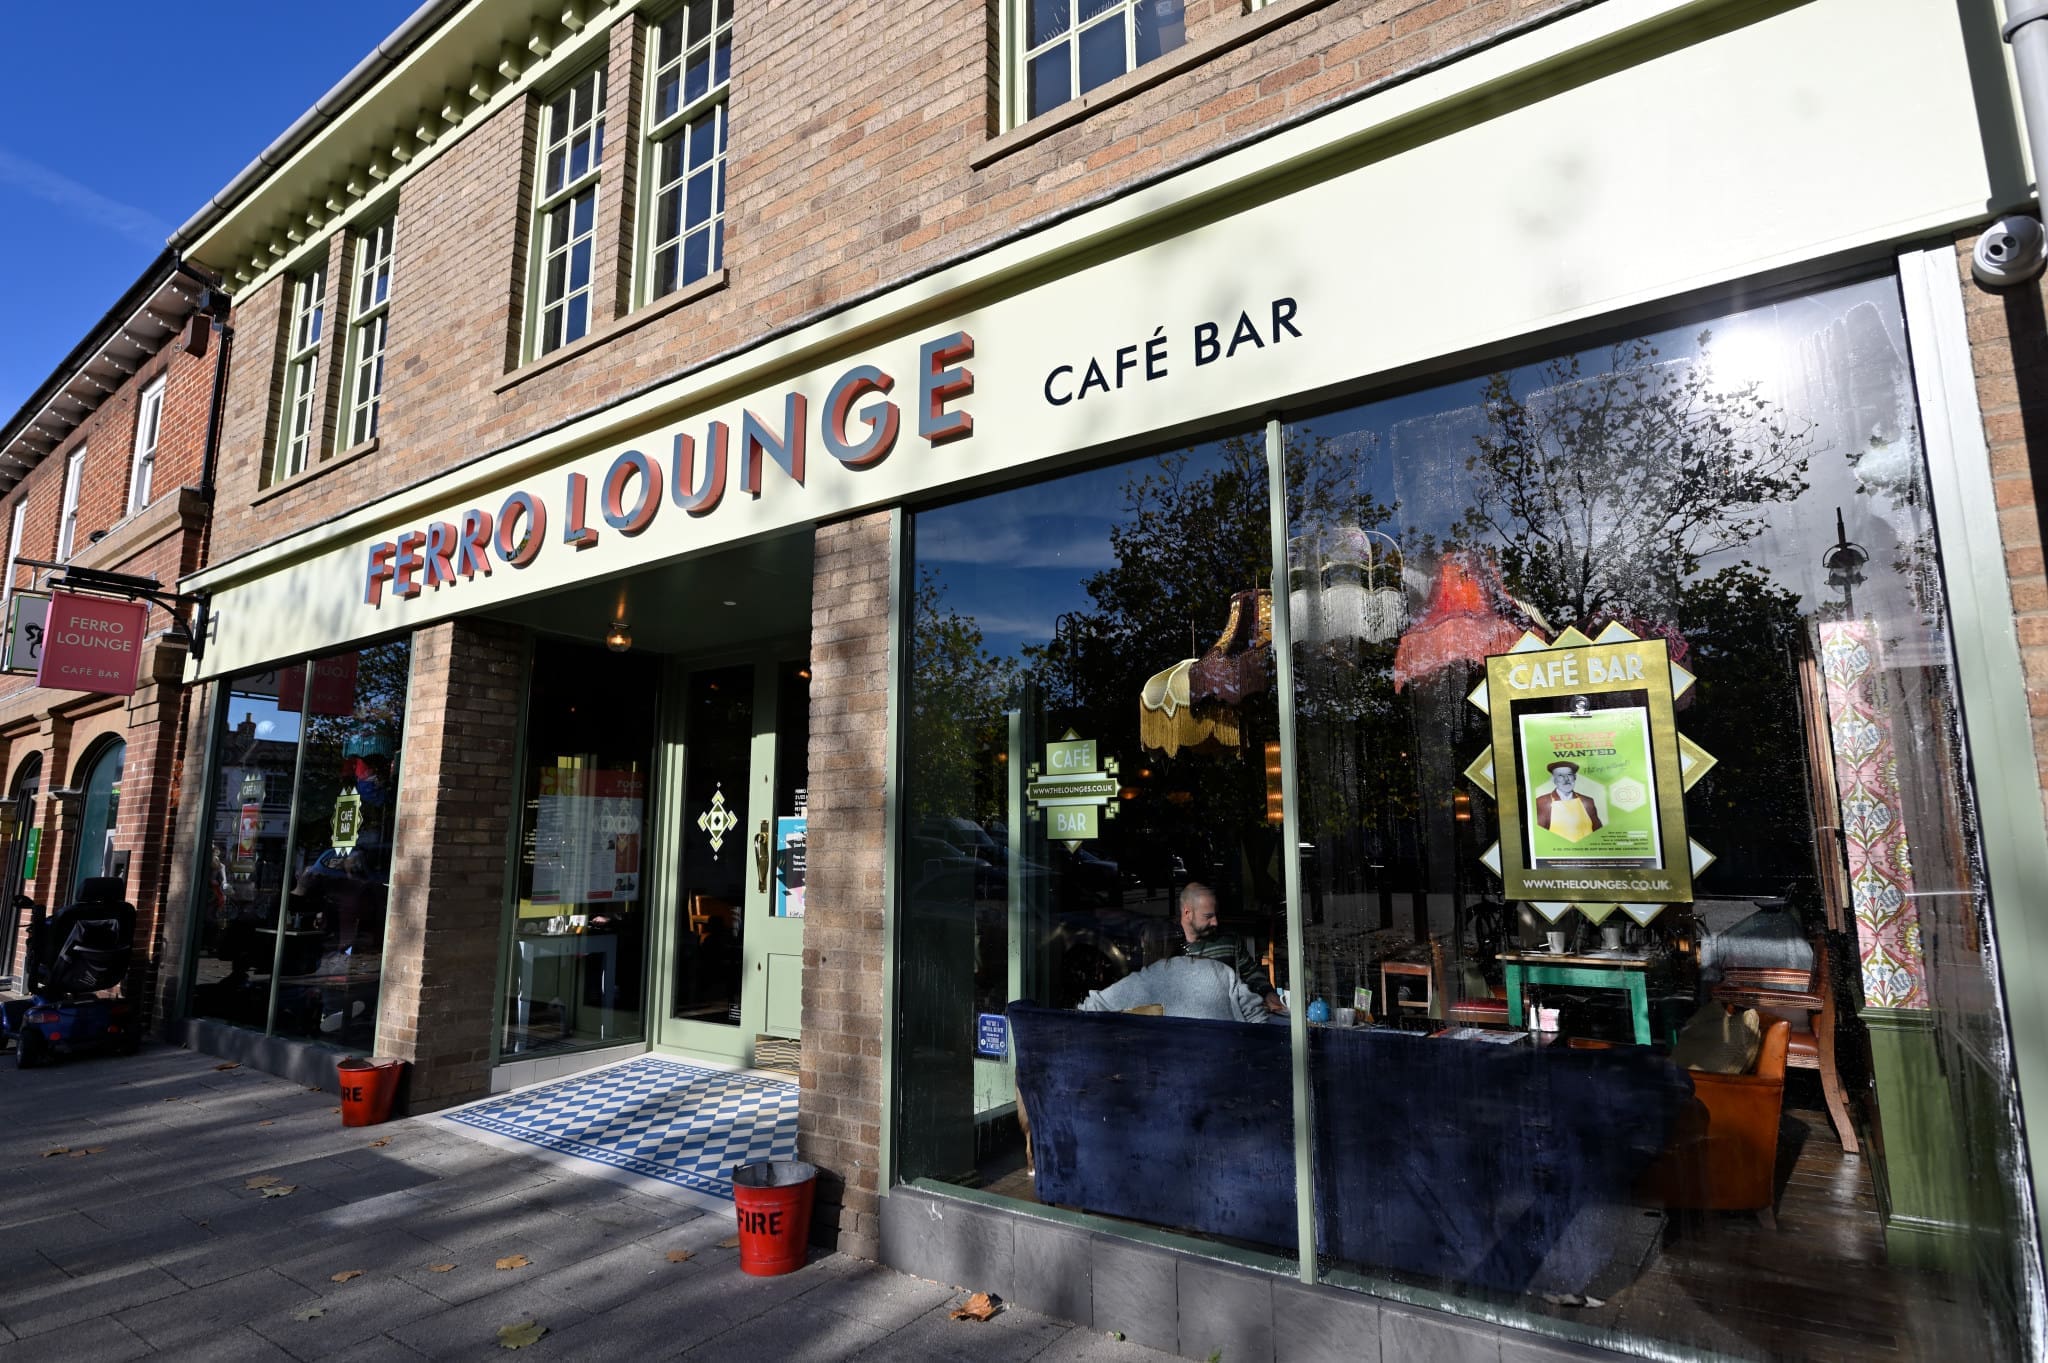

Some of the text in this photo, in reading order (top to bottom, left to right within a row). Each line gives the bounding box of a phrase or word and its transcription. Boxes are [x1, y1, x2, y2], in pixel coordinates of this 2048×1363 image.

[1044, 297, 1303, 406] CAFÉ BAR
[364, 330, 974, 609] FERRO LOUNGE
[69, 616, 124, 634] FERRO
[56, 631, 132, 652] LOUNGE
[98, 669, 120, 679] BAR
[1508, 653, 1645, 690] CAFÉ BAR
[1052, 743, 1091, 769] CAFÉ
[1552, 748, 1617, 759] WANTED
[1032, 784, 1113, 795] WWW.THELOUNGES.CO.UK
[340, 807, 353, 822] CAFÉ
[1057, 812, 1087, 832] BAR
[340, 822, 351, 834] BAR
[1523, 878, 1670, 891] WWW.THELOUNGES.CO.UK
[737, 1208, 784, 1236] FIRE
